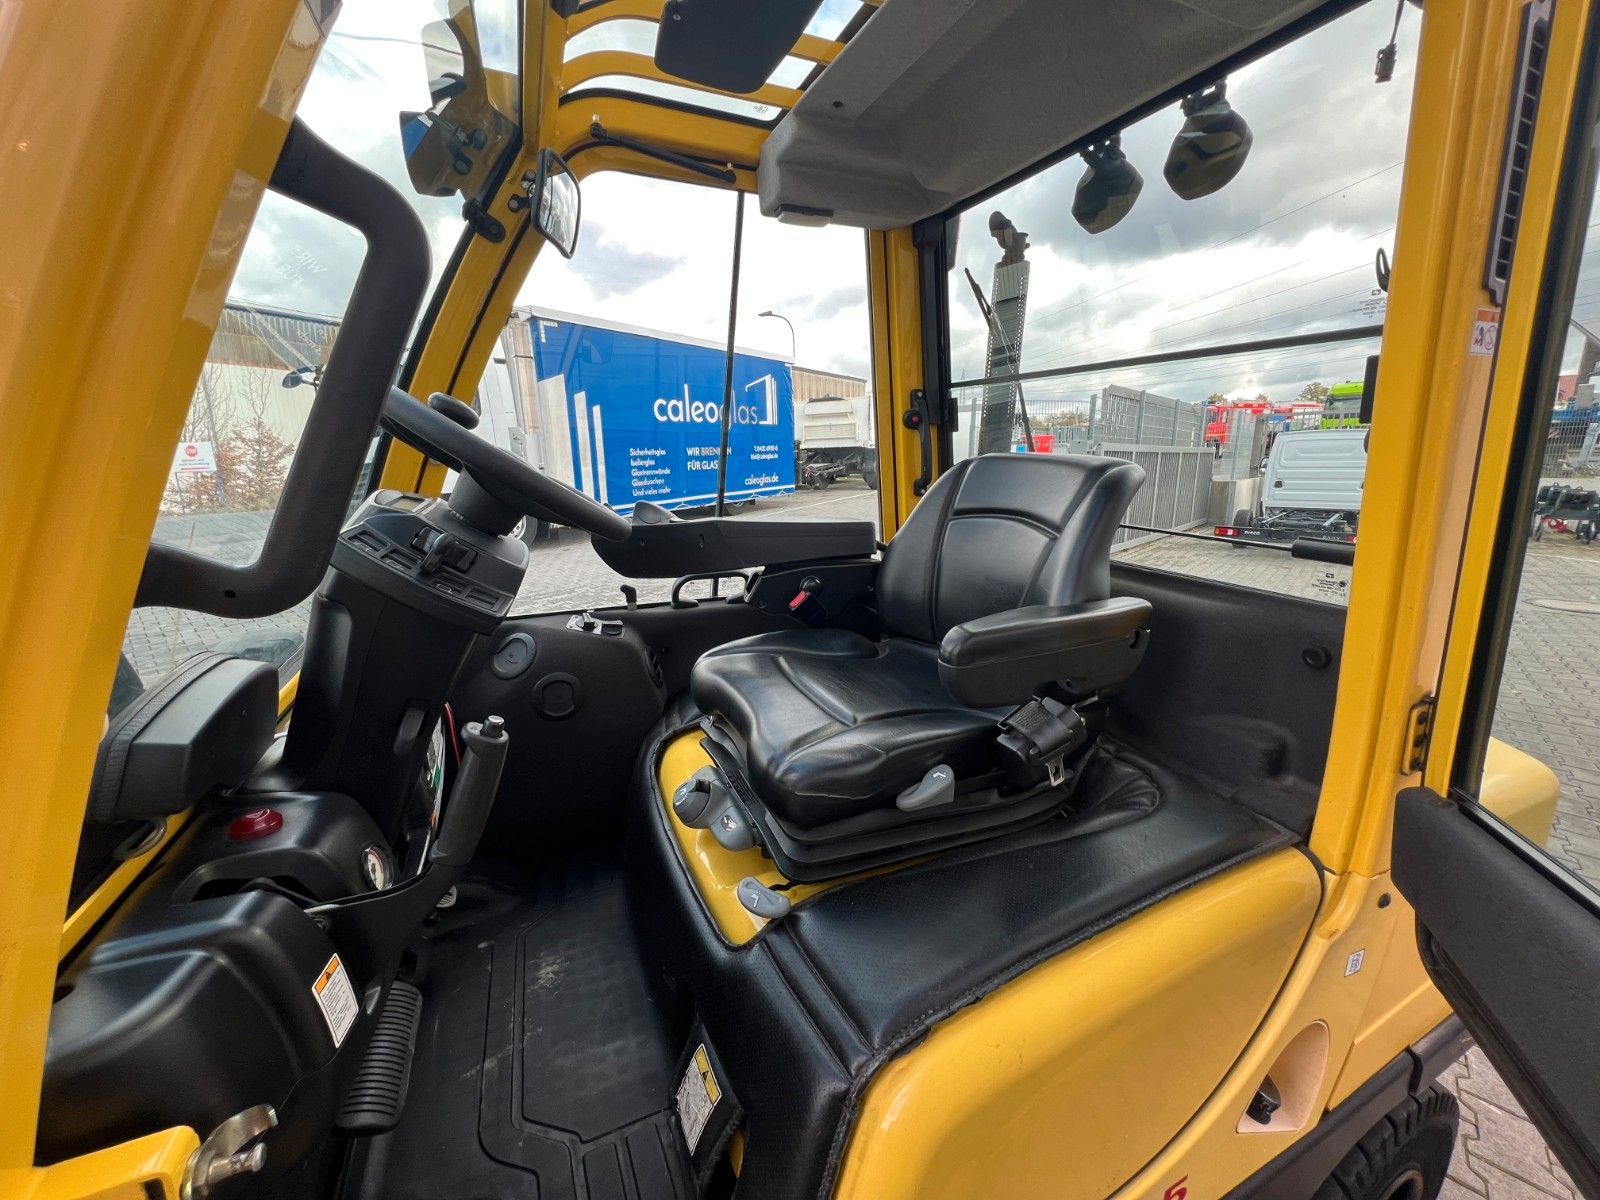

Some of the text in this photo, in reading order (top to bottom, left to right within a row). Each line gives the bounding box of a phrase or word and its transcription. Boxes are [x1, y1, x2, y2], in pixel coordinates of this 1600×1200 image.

[686, 446, 701, 457] WIR
[687, 459, 719, 471] FÜR GLAS
[744, 472, 779, 487] caleoglas.de
